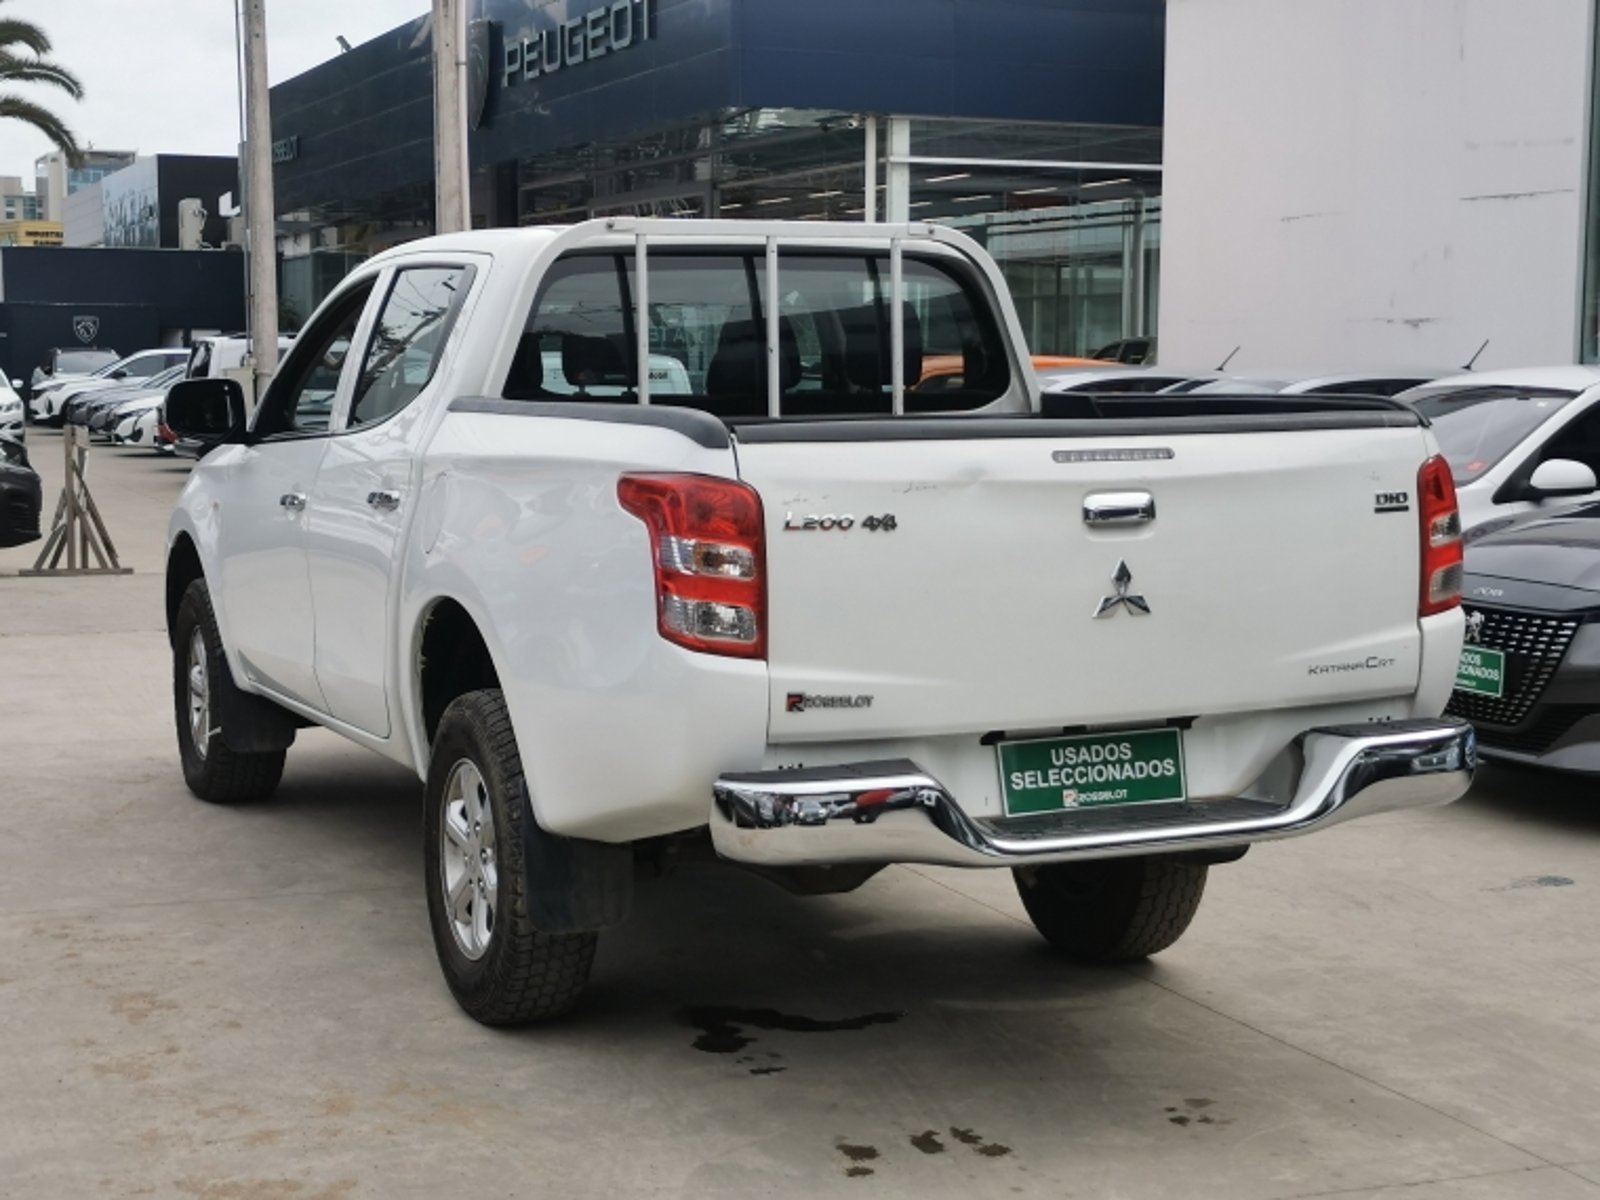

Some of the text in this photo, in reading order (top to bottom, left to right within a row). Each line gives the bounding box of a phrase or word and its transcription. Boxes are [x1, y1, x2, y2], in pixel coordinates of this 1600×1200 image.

[502, 0, 649, 87] PEUGEOT
[783, 511, 855, 531] L200
[1051, 742, 1132, 767] USADOS
[1010, 758, 1176, 791] SELECCIONADOS
